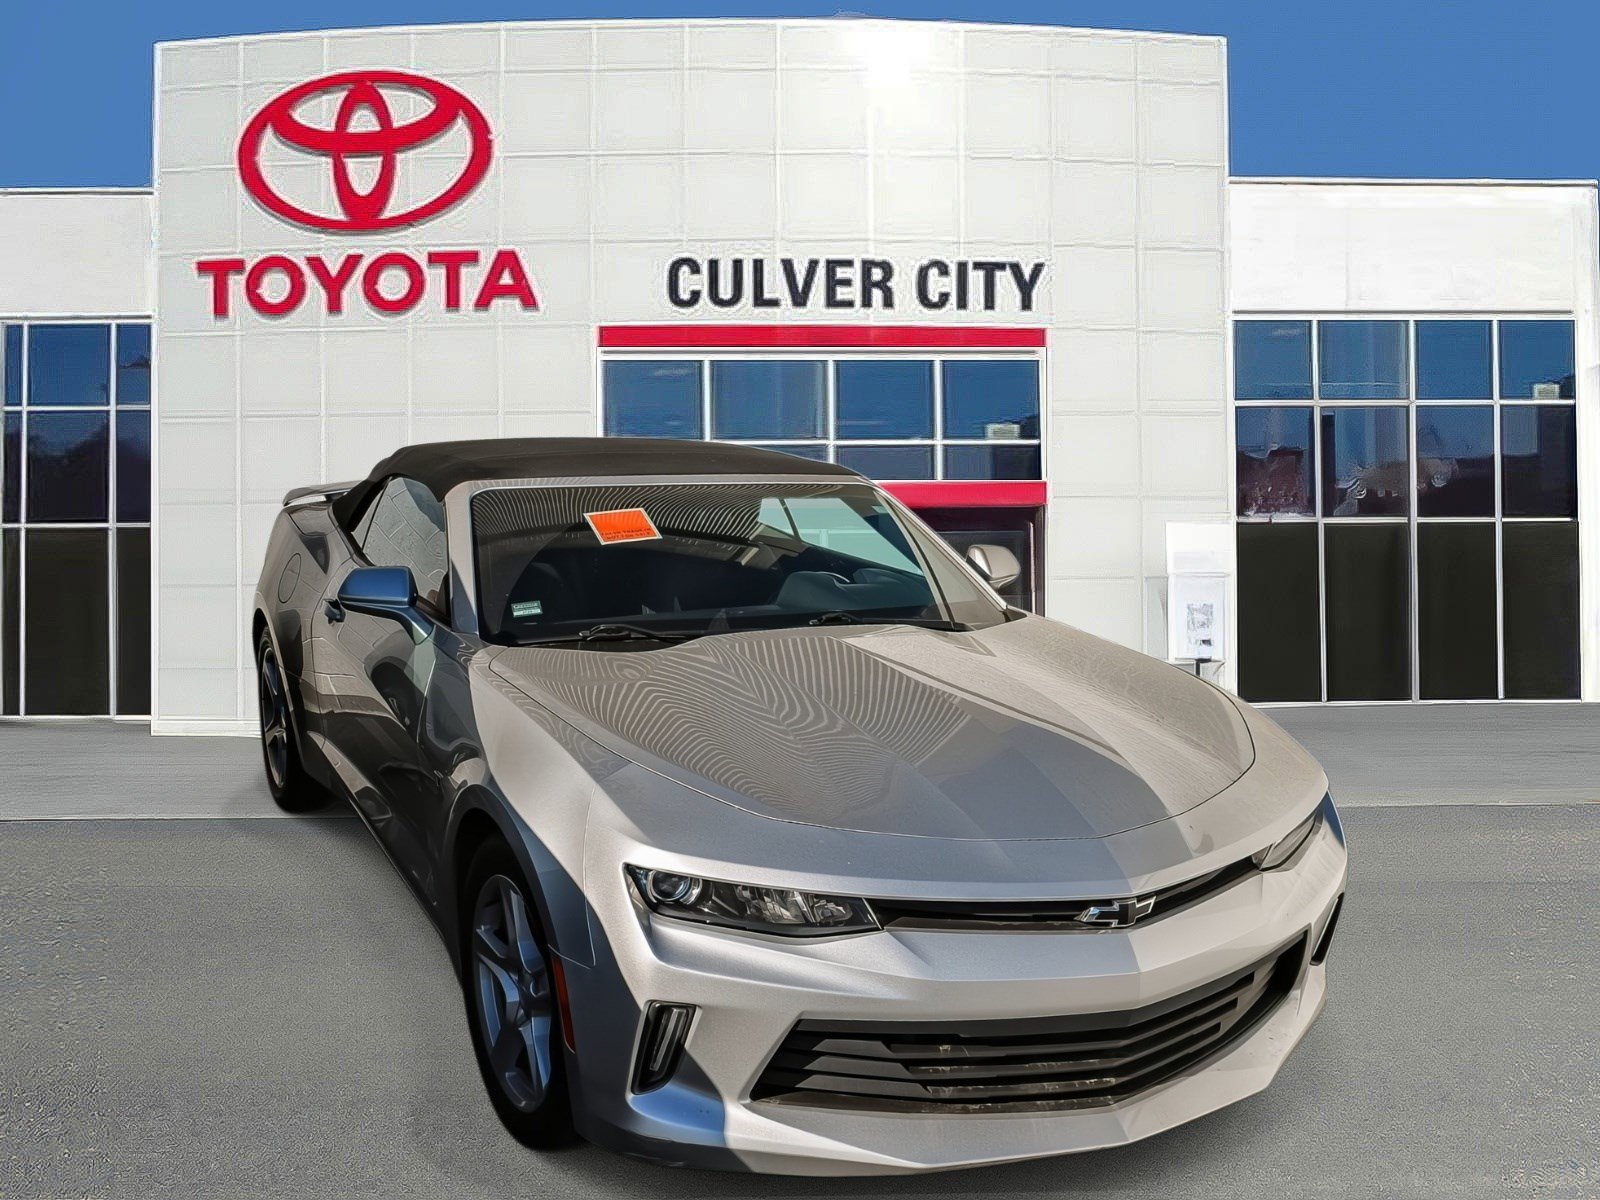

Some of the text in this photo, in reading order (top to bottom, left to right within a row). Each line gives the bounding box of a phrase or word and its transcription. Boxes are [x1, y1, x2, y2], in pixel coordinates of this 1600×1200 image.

[196, 250, 538, 316] TOYOTA
[668, 258, 1044, 311] CULVER CITY
